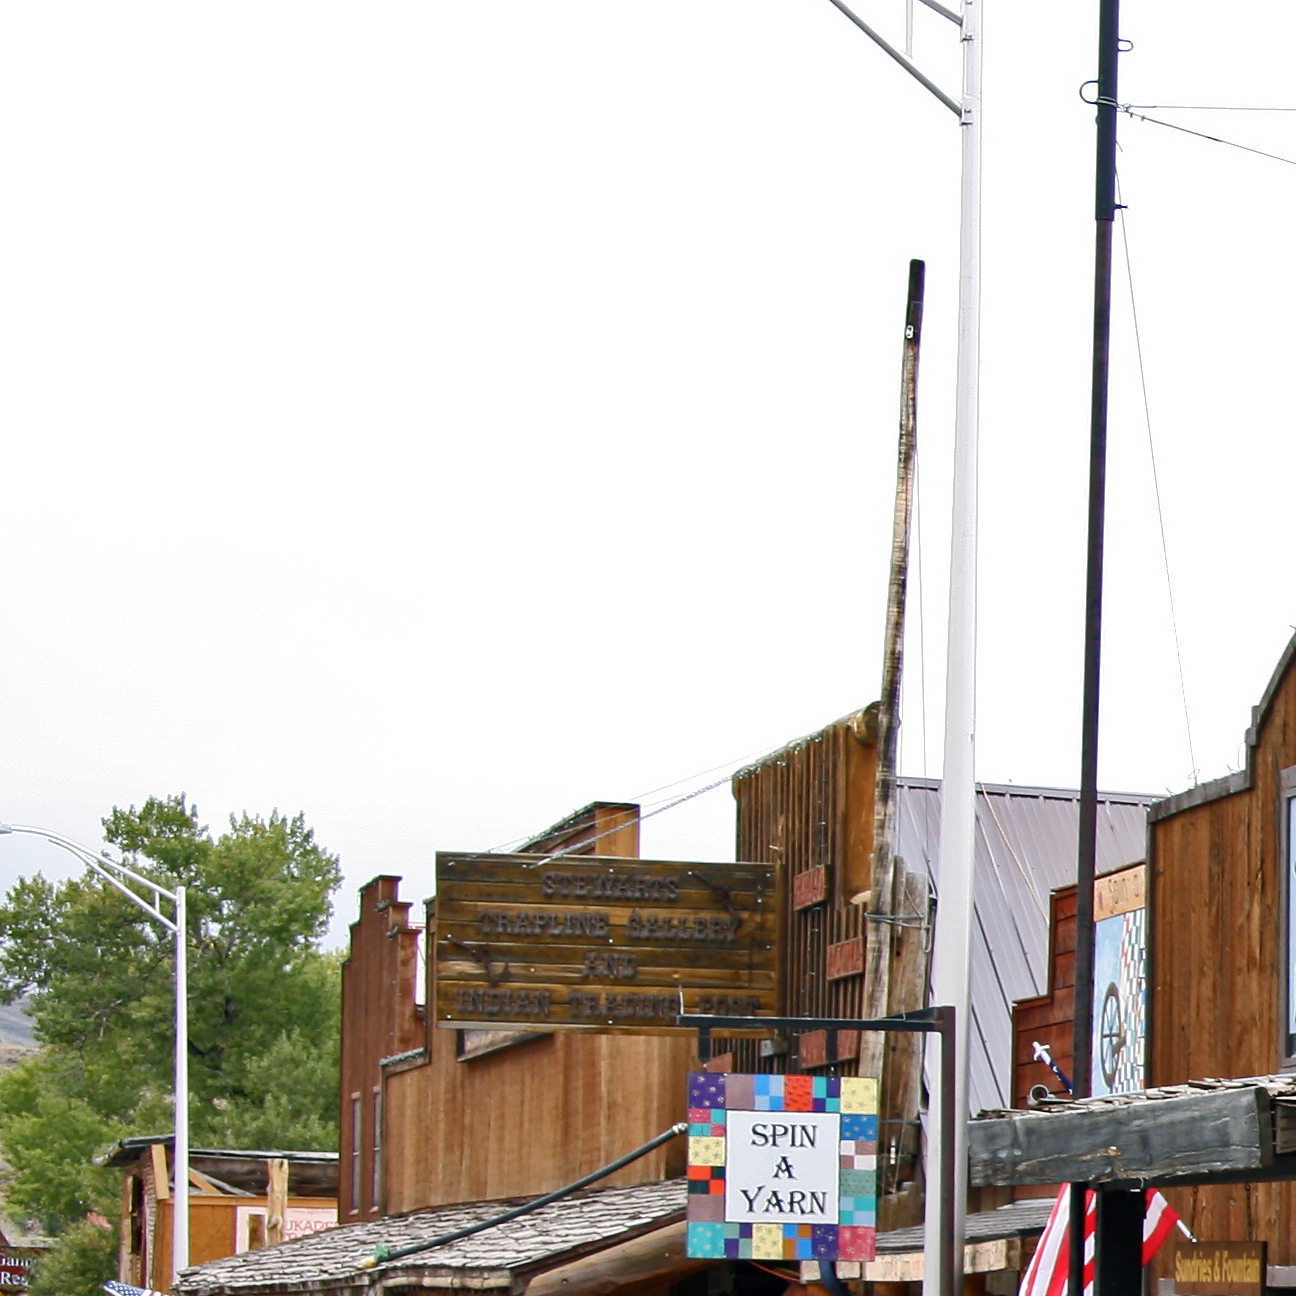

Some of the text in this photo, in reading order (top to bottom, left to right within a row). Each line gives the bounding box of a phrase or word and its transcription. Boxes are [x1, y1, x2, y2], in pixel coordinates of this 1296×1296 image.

[541, 870, 681, 900] STEWARTS
[478, 909, 741, 943] TRAPLINE GALLERY
[581, 952, 638, 980] AND
[456, 988, 551, 1015] INDIAN
[566, 991, 682, 1018] TRADING
[750, 1123, 818, 1147] SPIN
[773, 1155, 797, 1180] A
[739, 1185, 828, 1215] YARN
